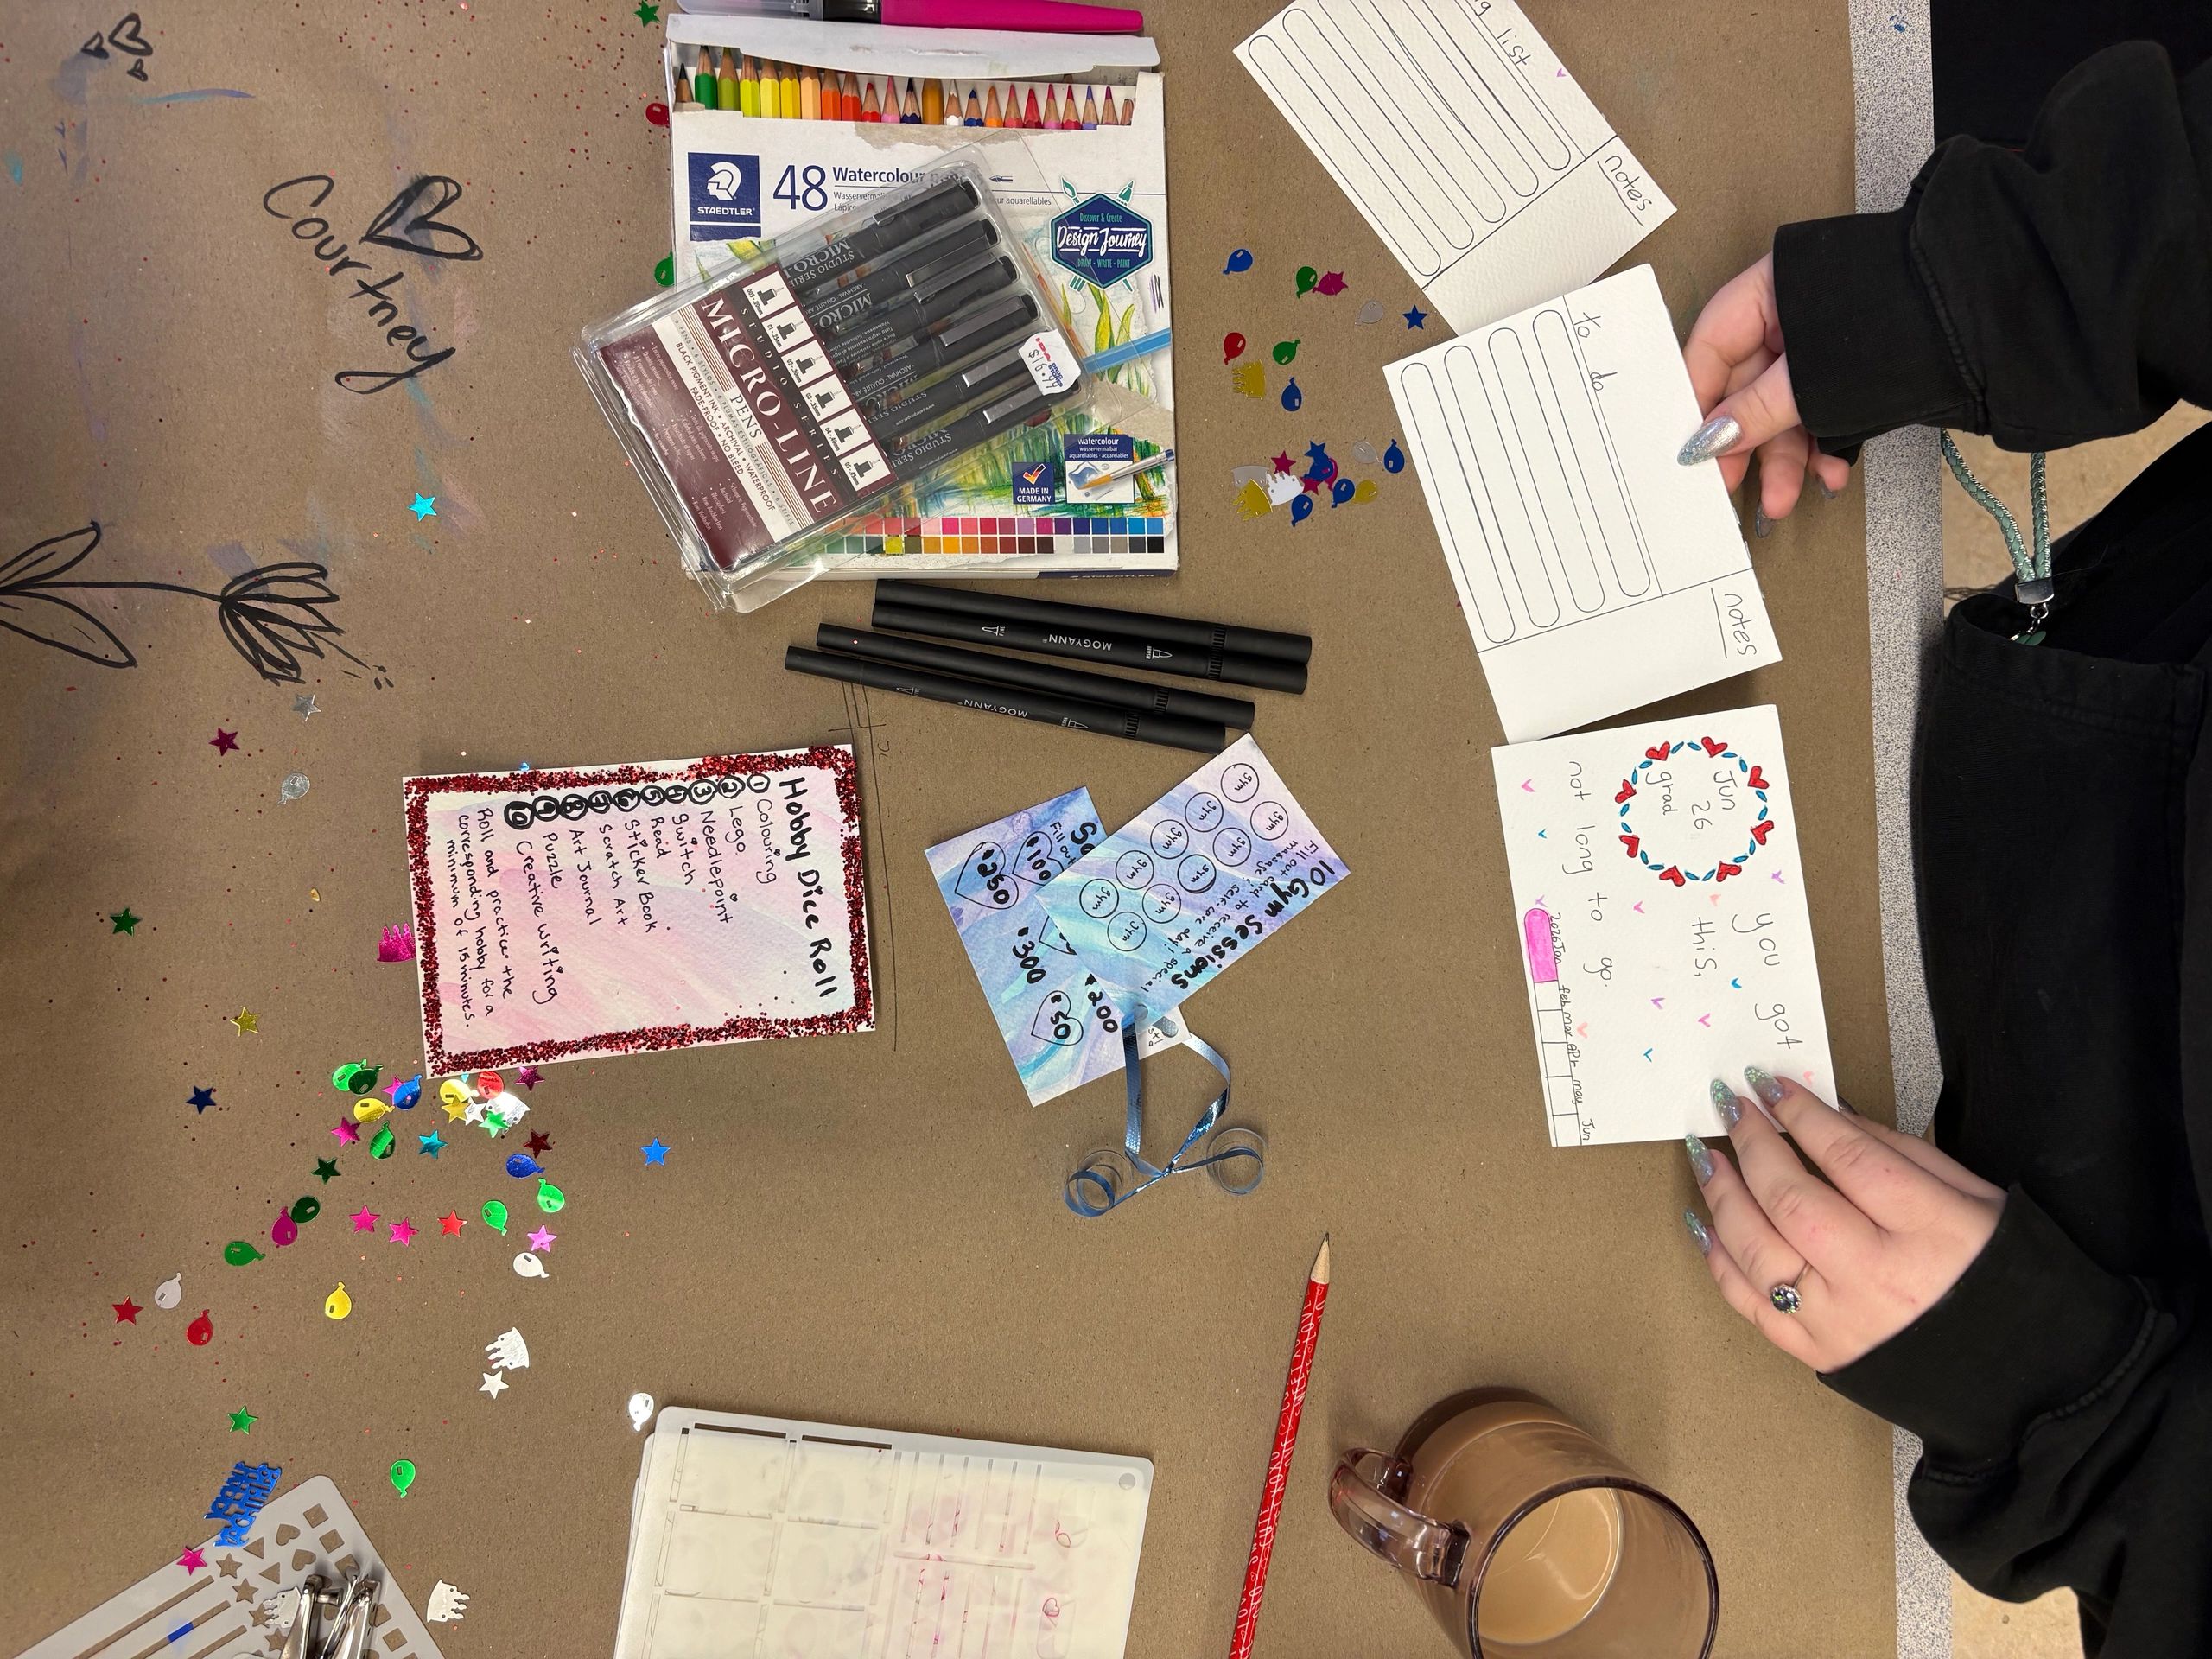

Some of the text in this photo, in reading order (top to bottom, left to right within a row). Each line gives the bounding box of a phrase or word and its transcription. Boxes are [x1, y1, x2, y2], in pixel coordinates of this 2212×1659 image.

[1497, 28, 1531, 65] list
[772, 164, 828, 211] 48
[832, 166, 925, 184] Watercolour
[1605, 156, 1652, 211] notes
[697, 207, 753, 216] STAEDTLER
[1006, 196, 1052, 207] aquarellables
[1080, 213, 1098, 223] Discover
[1106, 214, 1122, 223] Create
[1057, 226, 1147, 257] Design Journey
[816, 248, 855, 276] STUDIO
[1077, 259, 1130, 268] DRAW WRITE PAINT
[264, 175, 456, 394] Courtney
[1026, 347, 1058, 391] $16.99
[1574, 312, 1617, 392] to do
[678, 326, 691, 345] PENS
[697, 359, 715, 385] STYLOS
[721, 400, 739, 429] PLUMAS
[886, 363, 912, 380] ARCHIVAL
[1052, 362, 1063, 379] DRUG
[700, 292, 837, 517] MICRO-LINE
[740, 306, 839, 476] STUDIO SERIES
[675, 340, 693, 366] BLACK
[689, 365, 711, 399] PIGMENT
[708, 398, 720, 414] INK
[719, 419, 744, 457] ARCHIVAL
[743, 461, 775, 512] WATERPROOF
[690, 385, 720, 433] FADE-PROOF
[719, 438, 731, 453] NO
[728, 452, 744, 475] BLEED
[728, 392, 762, 440] PENS
[913, 431, 952, 458] STUDIO
[1078, 436, 1119, 445] watercolour
[1724, 592, 1758, 657] notes
[1049, 634, 1112, 652] MOGYANN
[1234, 772, 1252, 791] gym
[1568, 761, 1589, 802] not
[1645, 772, 1679, 816] grad
[1713, 770, 1737, 810] Jun
[476, 807, 496, 842] Roll
[1199, 801, 1216, 820] gym
[1266, 811, 1283, 831] gym
[1690, 800, 1712, 830] 26
[569, 829, 587, 855] Art
[650, 816, 671, 859] Read
[722, 805, 747, 854] Lego
[749, 798, 782, 885] Colouring
[1050, 822, 1065, 842] Fill
[1162, 827, 1182, 849] gym
[484, 849, 499, 877] and
[542, 832, 563, 889] Puzzle
[671, 812, 700, 886] Switch
[1228, 837, 1245, 857] gym
[1255, 841, 1298, 875] massage
[1296, 840, 1319, 860] Fill
[1561, 825, 1596, 875] long
[515, 840, 545, 918] Creative
[598, 823, 623, 890] Scratch
[613, 897, 628, 926] Art
[624, 819, 651, 887] Sticker
[638, 891, 658, 933] Book
[699, 809, 737, 925] Needlepoint
[1127, 859, 1147, 880] gym
[1191, 864, 1209, 883] gym
[1281, 859, 1297, 876] out
[575, 860, 602, 926] Journal
[779, 776, 837, 998] Hobby Dice Roll
[1092, 887, 1110, 910] gym
[1155, 893, 1175, 914] gym
[1250, 876, 1274, 898] card
[455, 814, 494, 1016] corresponding hobby for a
[1235, 899, 1248, 910] to
[1587, 892, 1608, 922] to
[445, 839, 476, 1028] minimum of 15 minutes.
[1122, 921, 1139, 941] gym
[1164, 928, 1190, 954] day!
[1171, 860, 1335, 989] 10 Gym Sessions
[1194, 914, 1230, 946] receive
[499, 965, 515, 1000] the
[1141, 958, 1178, 992] special
[1732, 912, 1804, 1050] you got
[1582, 1118, 1596, 1141] Jun
